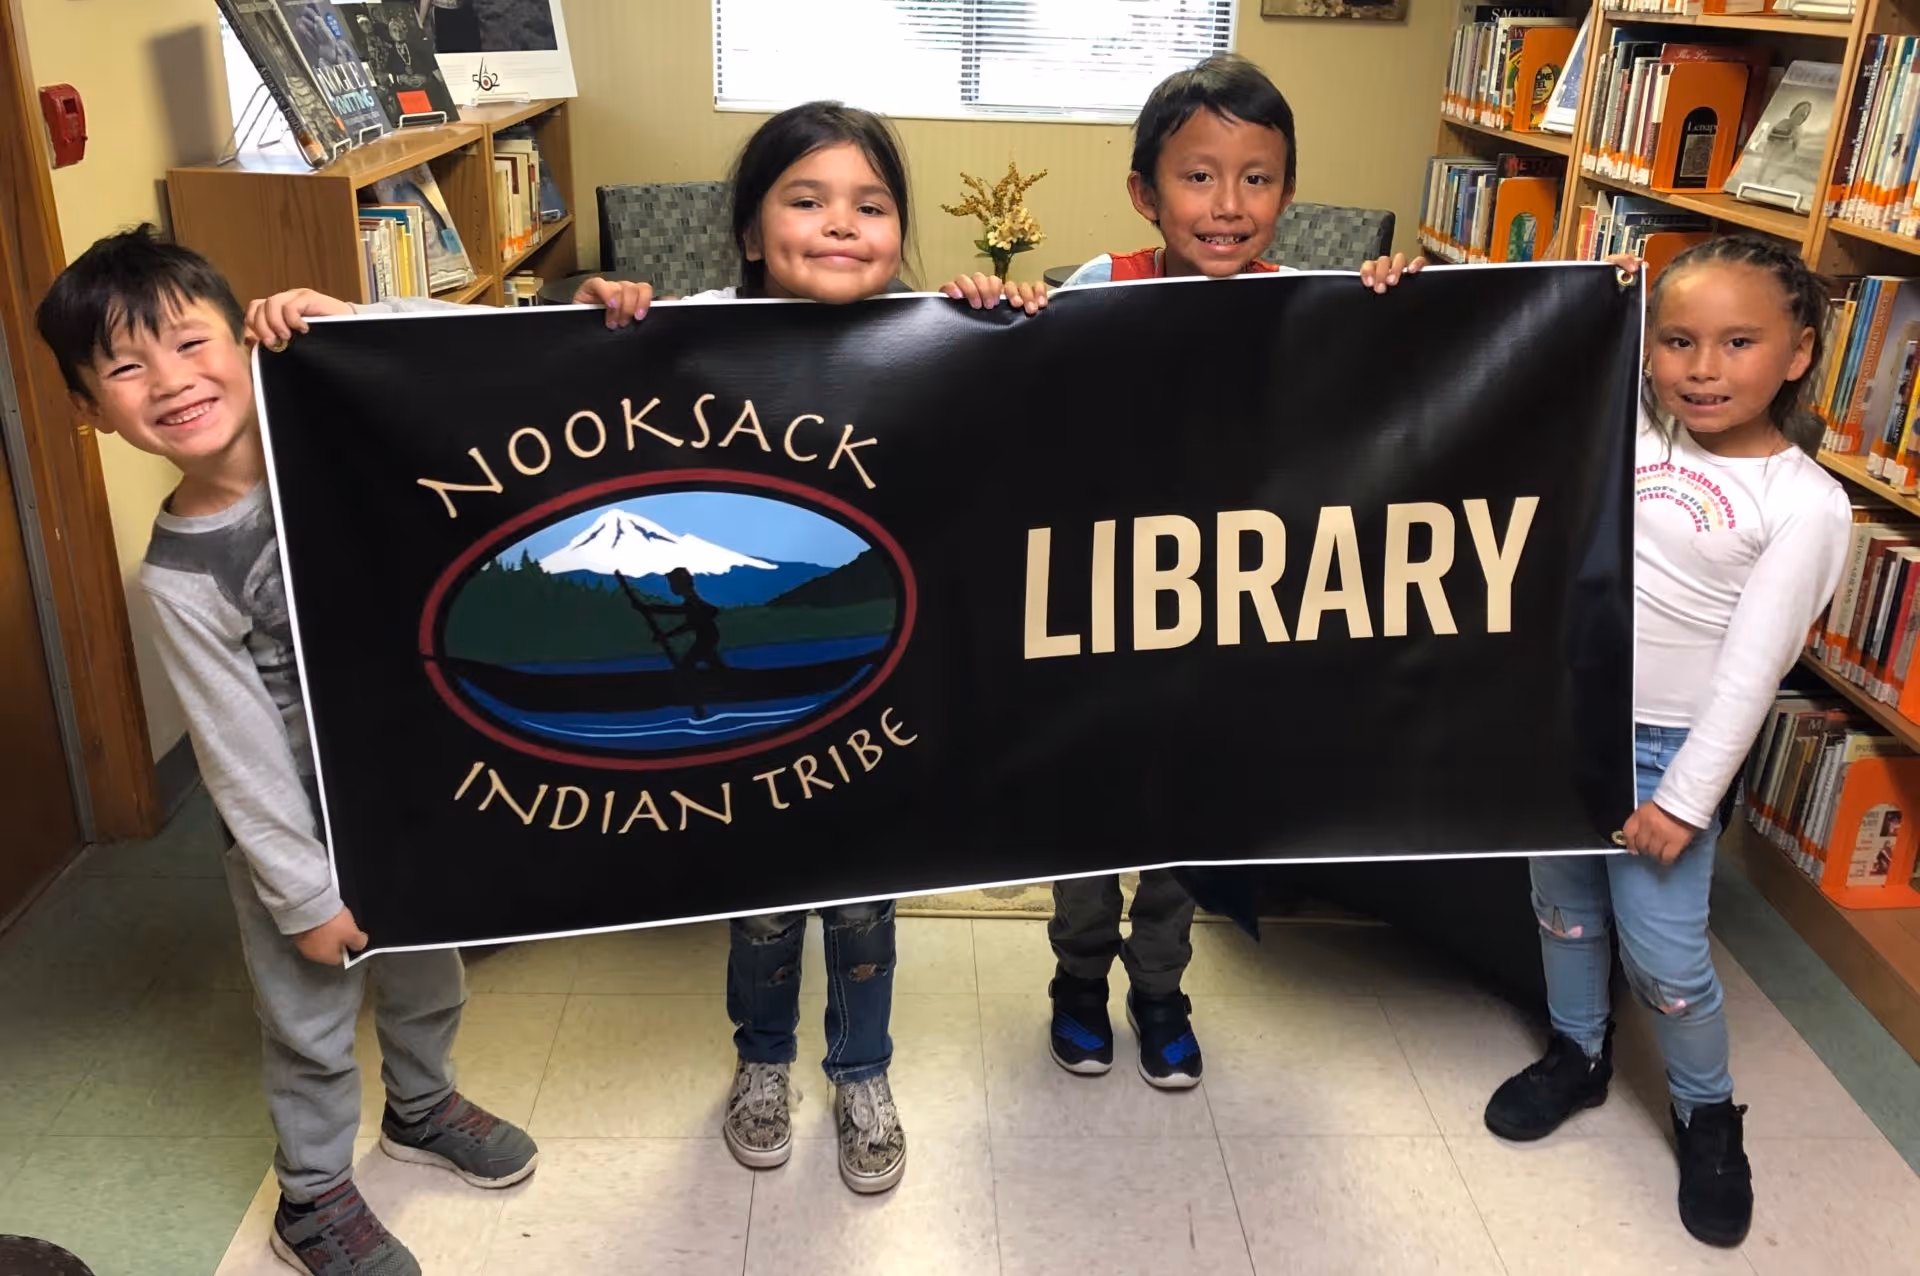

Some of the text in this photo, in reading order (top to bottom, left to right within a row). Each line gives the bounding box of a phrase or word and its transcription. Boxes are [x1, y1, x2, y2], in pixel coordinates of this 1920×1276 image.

[318, 61, 367, 95] VOGUE
[333, 89, 375, 115] KNITTING
[1687, 121, 1717, 134] Lenap
[417, 393, 878, 518] NOOKSACK
[1679, 466, 1736, 529] rainbows
[1024, 496, 1540, 660] LIBRARY
[455, 707, 918, 834] INDIAN TRIBE
